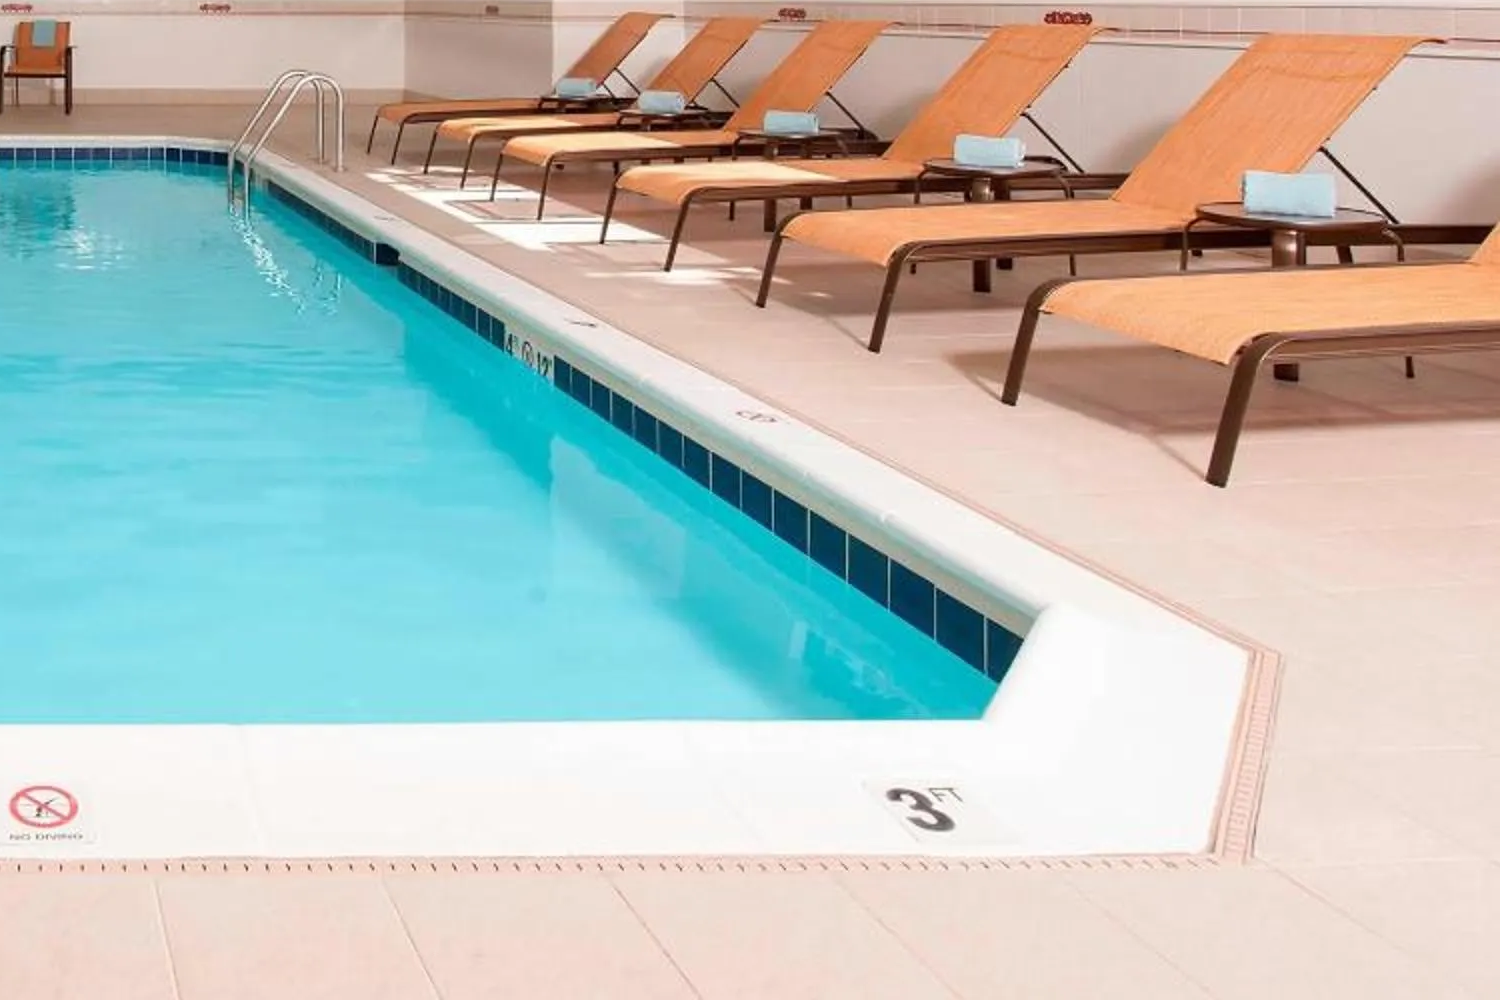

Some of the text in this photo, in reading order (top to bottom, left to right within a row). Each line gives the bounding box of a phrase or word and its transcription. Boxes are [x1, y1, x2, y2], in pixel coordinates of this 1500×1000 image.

[505, 333, 513, 357] 4
[886, 787, 963, 832] 3 FT
[9, 833, 84, 841] NO DIVING
